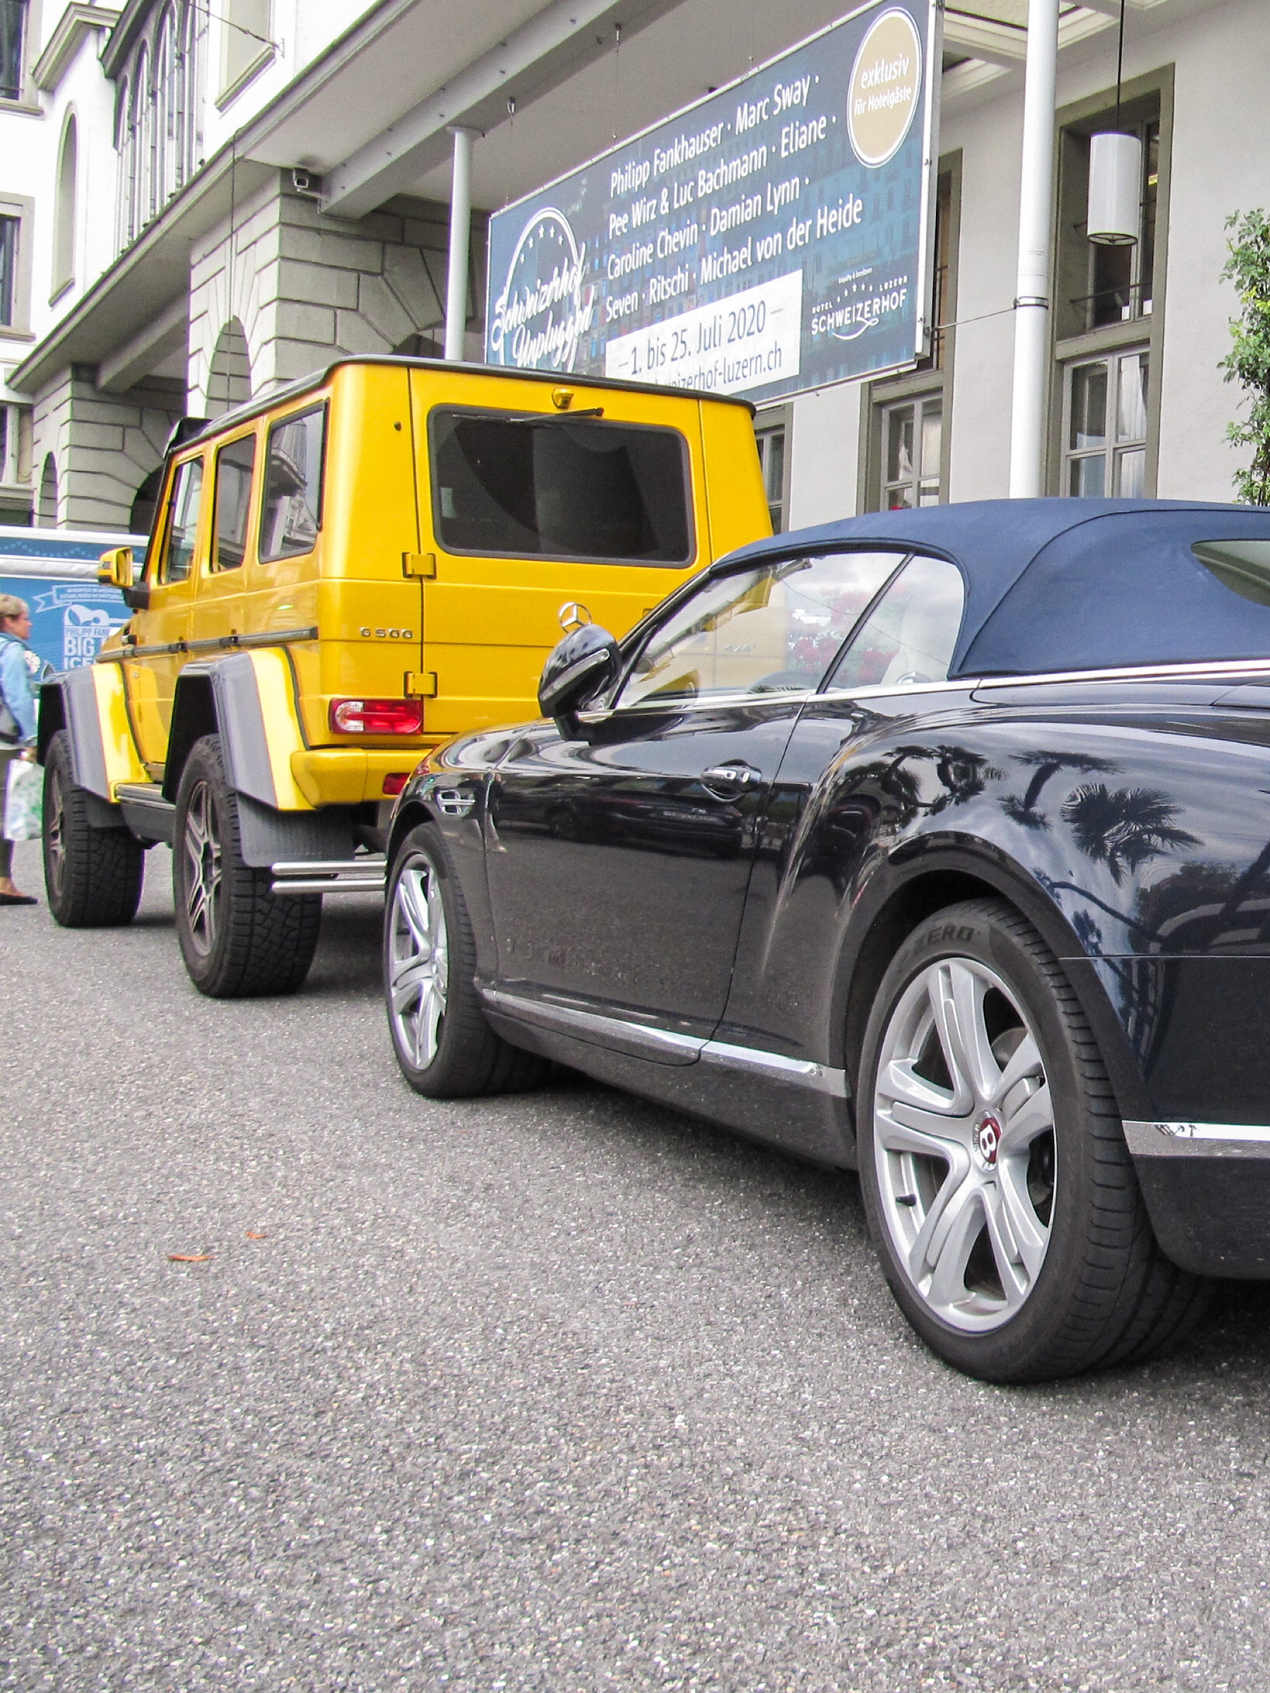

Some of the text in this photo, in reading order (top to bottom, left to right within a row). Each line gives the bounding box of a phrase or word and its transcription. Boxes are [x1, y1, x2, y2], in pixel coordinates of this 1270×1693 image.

[854, 86, 912, 117] für Hotelgäste
[861, 53, 910, 90] exklusiv
[610, 75, 812, 198] Philipp Fankhauser Marc Sway
[609, 115, 827, 240] Pee Wirz & Luc Bachmann Eliane
[605, 192, 864, 323] Seven Ritschi Michael von der Heide
[607, 177, 800, 281] Caroline Chevin Damian Lynn
[647, 336, 667, 370] bis
[670, 328, 692, 362] 25.
[696, 314, 722, 355] Juli
[727, 300, 766, 344] 2020
[811, 288, 908, 340] SCHWEIZERHOF
[65, 638, 95, 657] BIG
